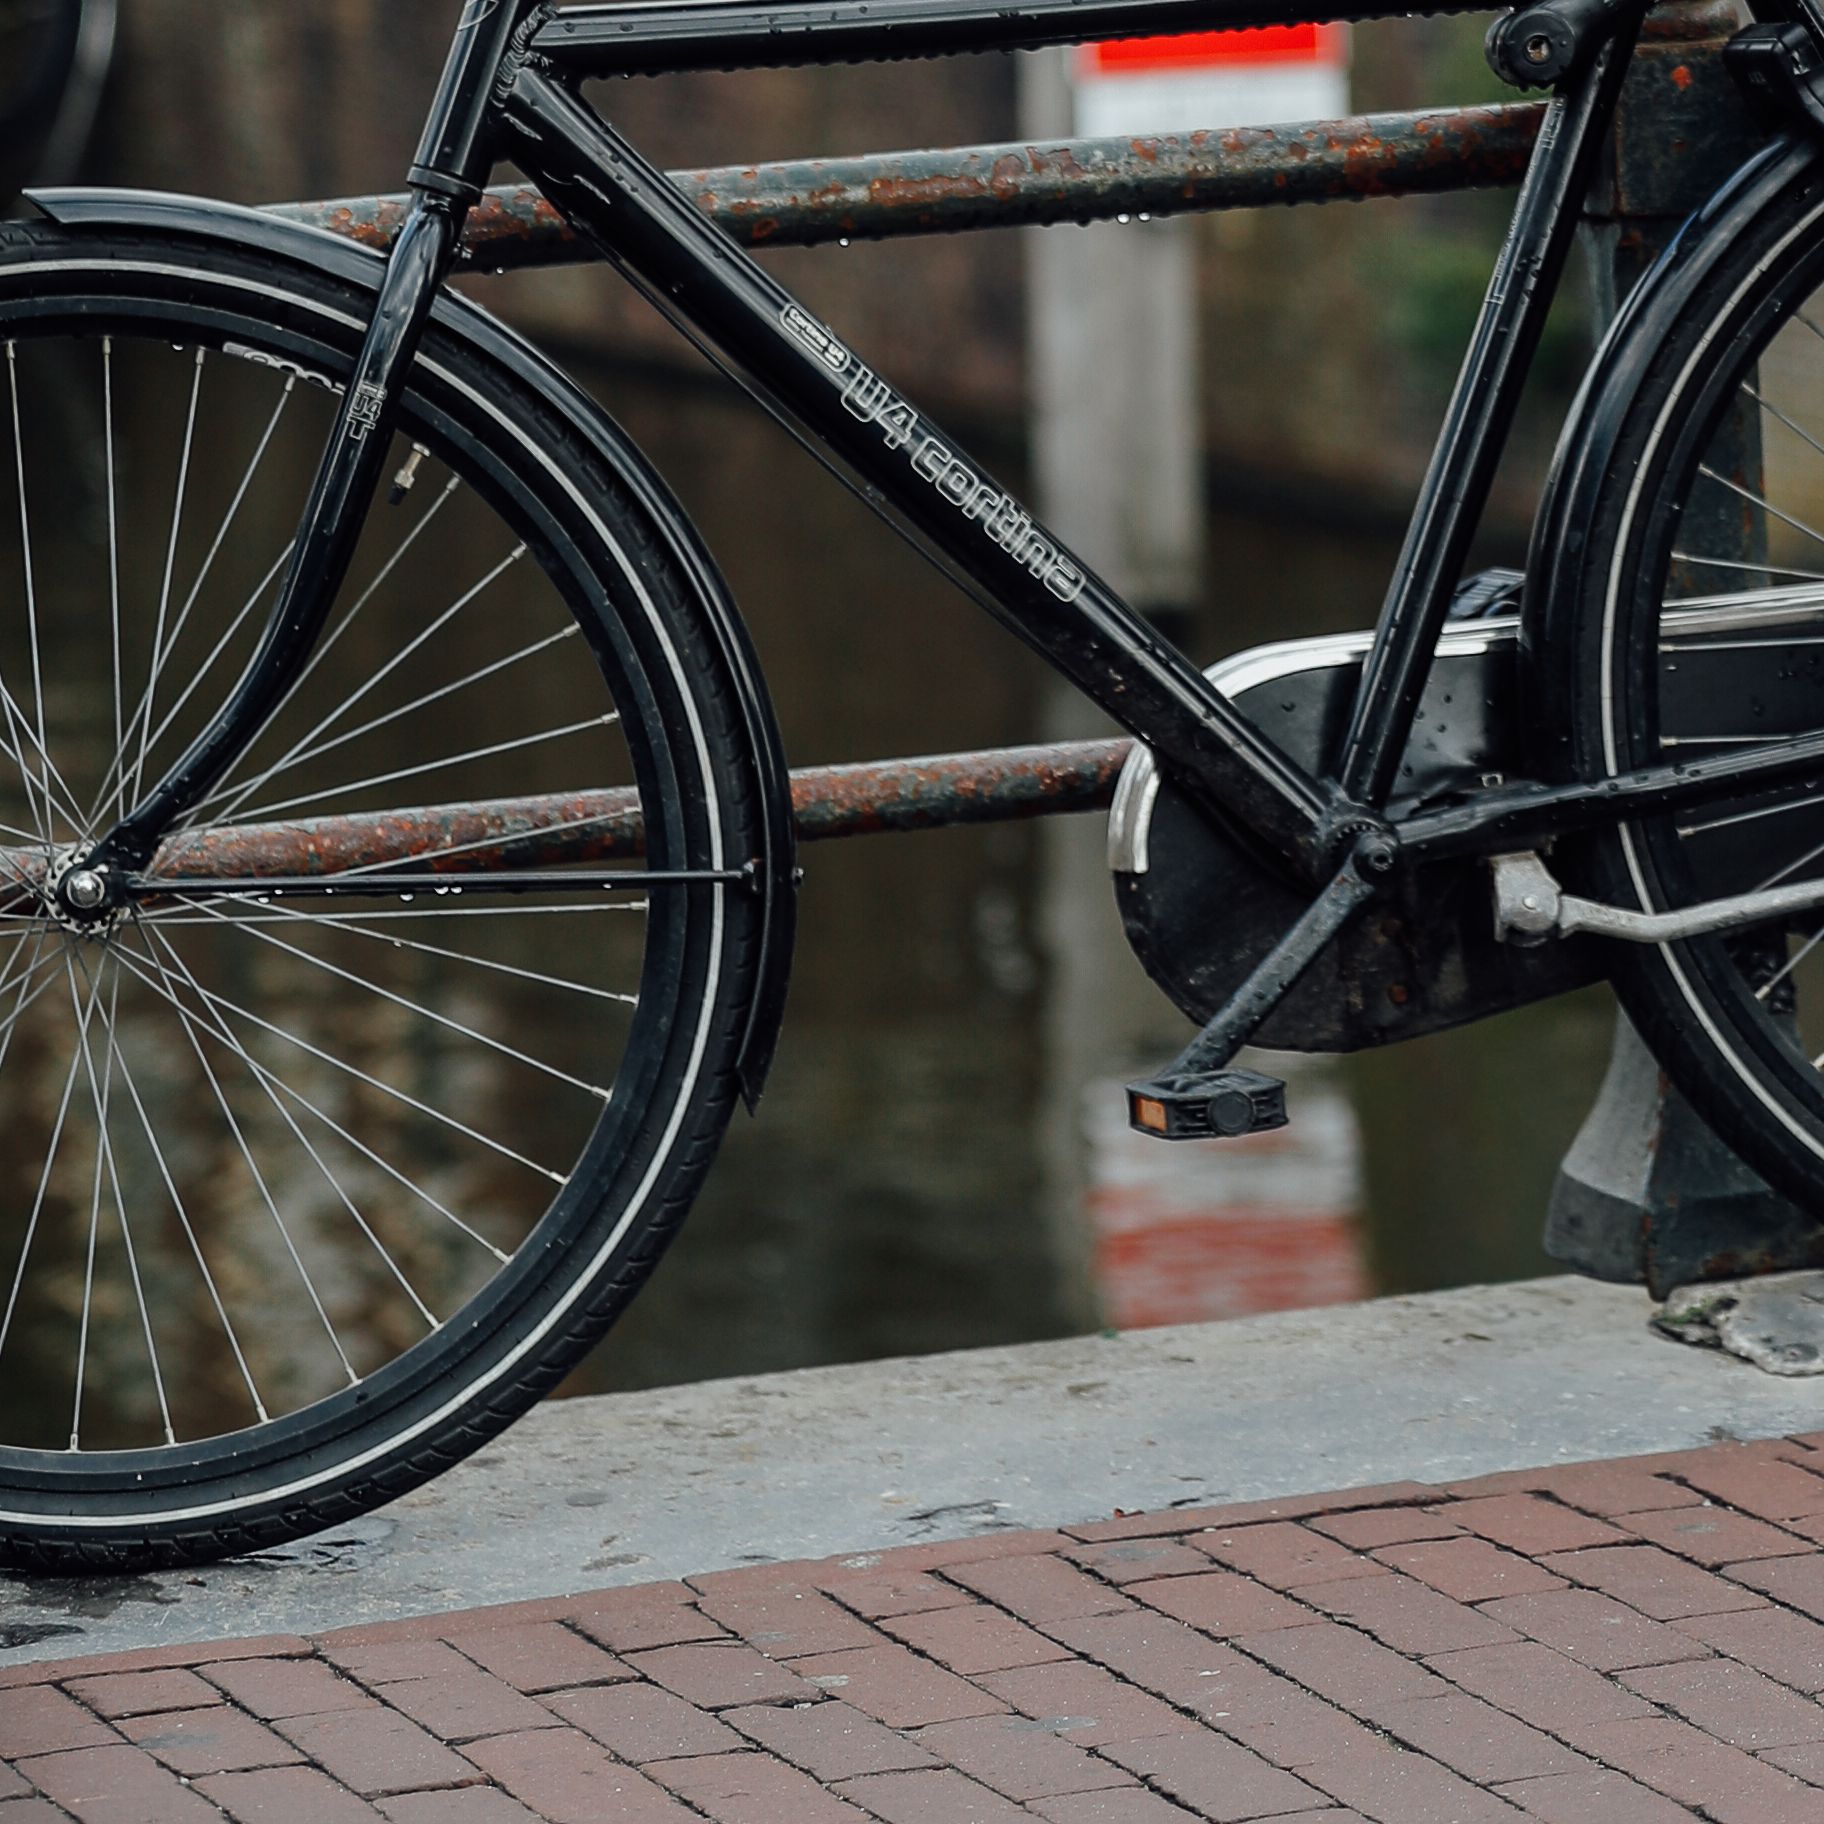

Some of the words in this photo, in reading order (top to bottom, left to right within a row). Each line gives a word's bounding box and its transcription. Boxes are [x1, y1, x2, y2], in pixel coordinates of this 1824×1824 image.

[349, 391, 383, 422] U4
[840, 363, 919, 450] U4
[910, 435, 1087, 603] cortina
